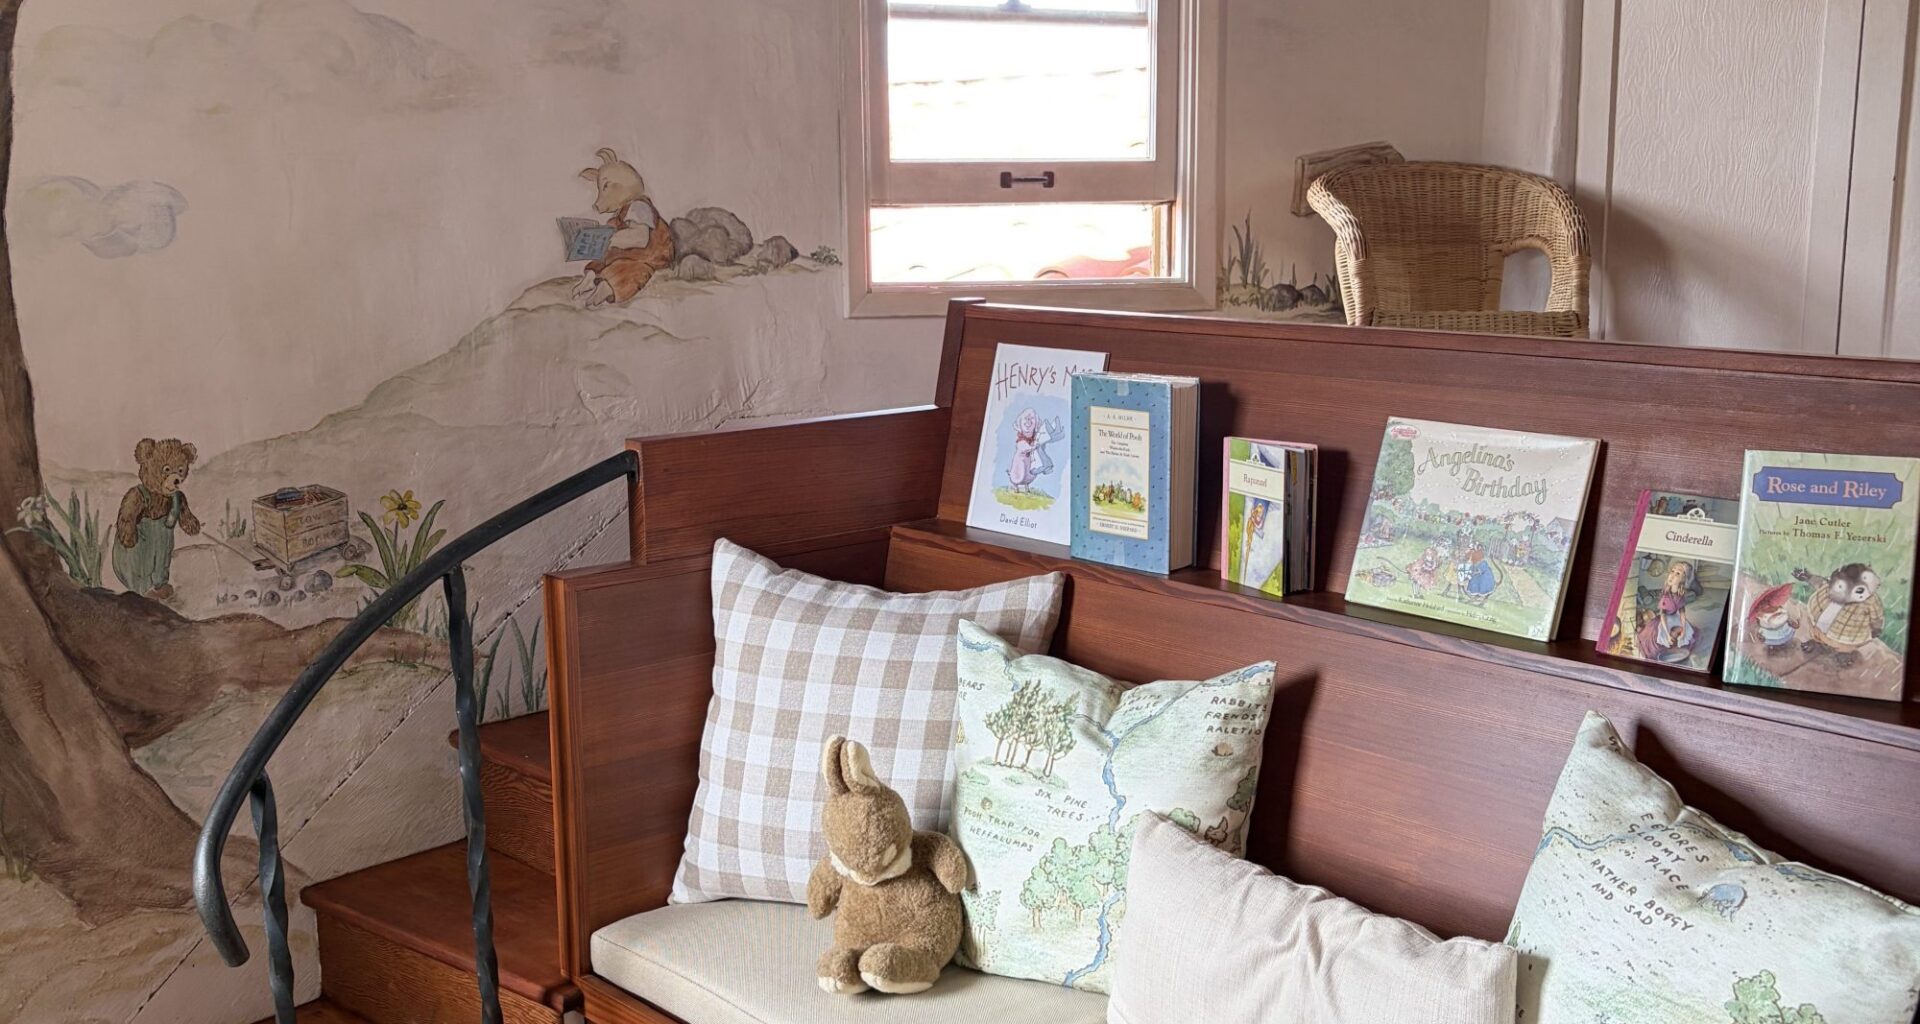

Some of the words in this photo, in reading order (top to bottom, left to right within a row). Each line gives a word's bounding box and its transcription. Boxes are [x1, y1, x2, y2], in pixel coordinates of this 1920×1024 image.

[1098, 429, 1107, 437] The
[1108, 430, 1122, 438] World
[1417, 443, 1515, 476] Angelina's
[1462, 468, 1548, 505] Birthday
[1767, 476, 1806, 494] Rose
[1810, 481, 1838, 495] and
[1843, 480, 1887, 500] Riley
[1000, 513, 1018, 524] David
[1794, 516, 1815, 526] Jane
[1819, 518, 1852, 528] Cutler
[1665, 531, 1713, 546] Cinderella
[1792, 528, 1831, 539] Thomas
[1846, 532, 1886, 543] Yezerski
[1035, 788, 1052, 800] SIX
[1064, 794, 1088, 809] PINE
[970, 826, 1034, 852] HEFFALUMPS
[989, 815, 1014, 828] TRAP
[1022, 826, 1040, 839] FOR
[1628, 823, 1686, 863] GLOOMY
[1644, 855, 1689, 891] PLACE
[1590, 858, 1638, 896] RATHER
[1644, 899, 1695, 931] BOGGY
[1592, 883, 1614, 900] AND
[1624, 904, 1653, 925] SAD
